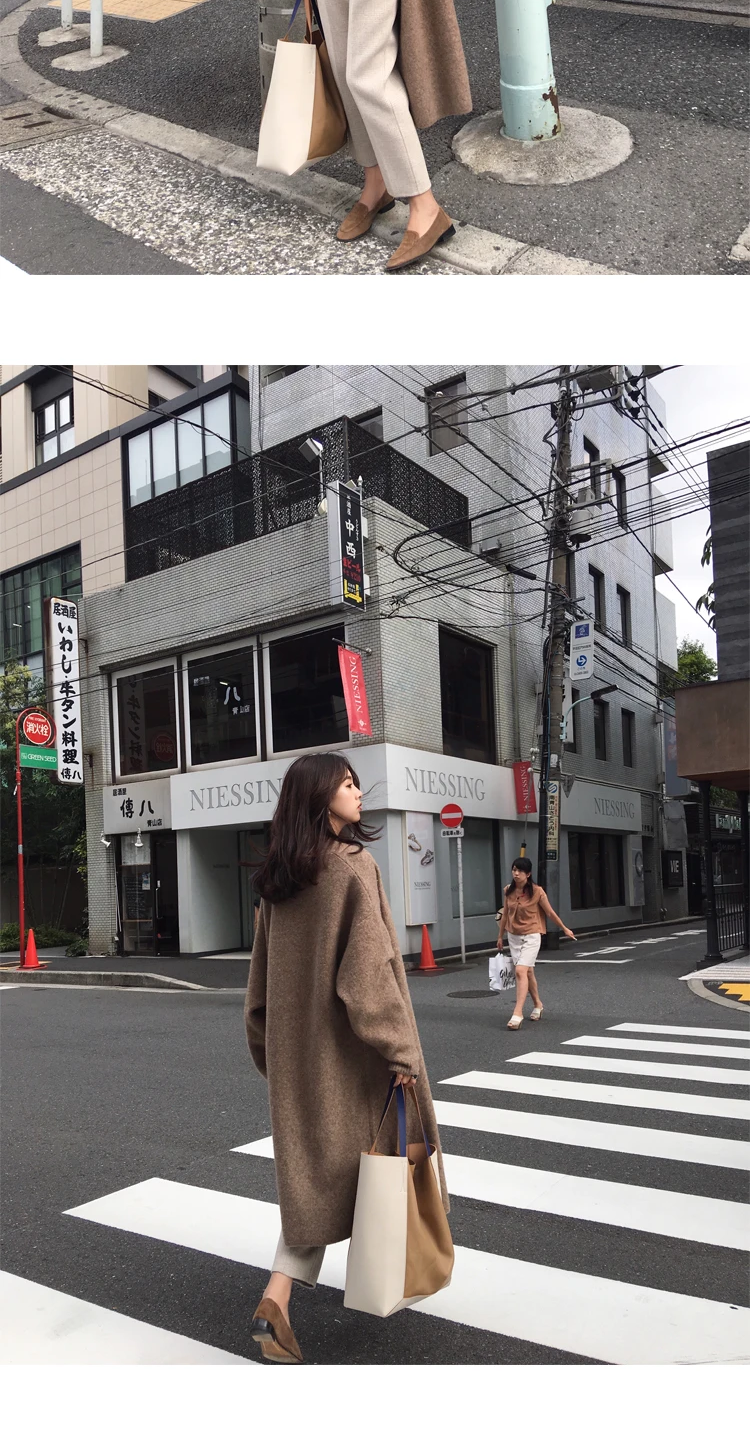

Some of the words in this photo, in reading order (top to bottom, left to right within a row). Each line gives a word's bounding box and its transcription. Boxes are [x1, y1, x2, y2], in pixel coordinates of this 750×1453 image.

[53, 602, 77, 620] 居酒屋
[57, 621, 80, 765] いわし・牛タン料理
[348, 656, 363, 714] NIESSING
[26, 721, 49, 737] 消火栓
[190, 778, 283, 811] NIESSIN
[405, 767, 486, 801] NIESSING
[594, 797, 635, 819] NIESSING
[147, 819, 163, 828] 青山店
